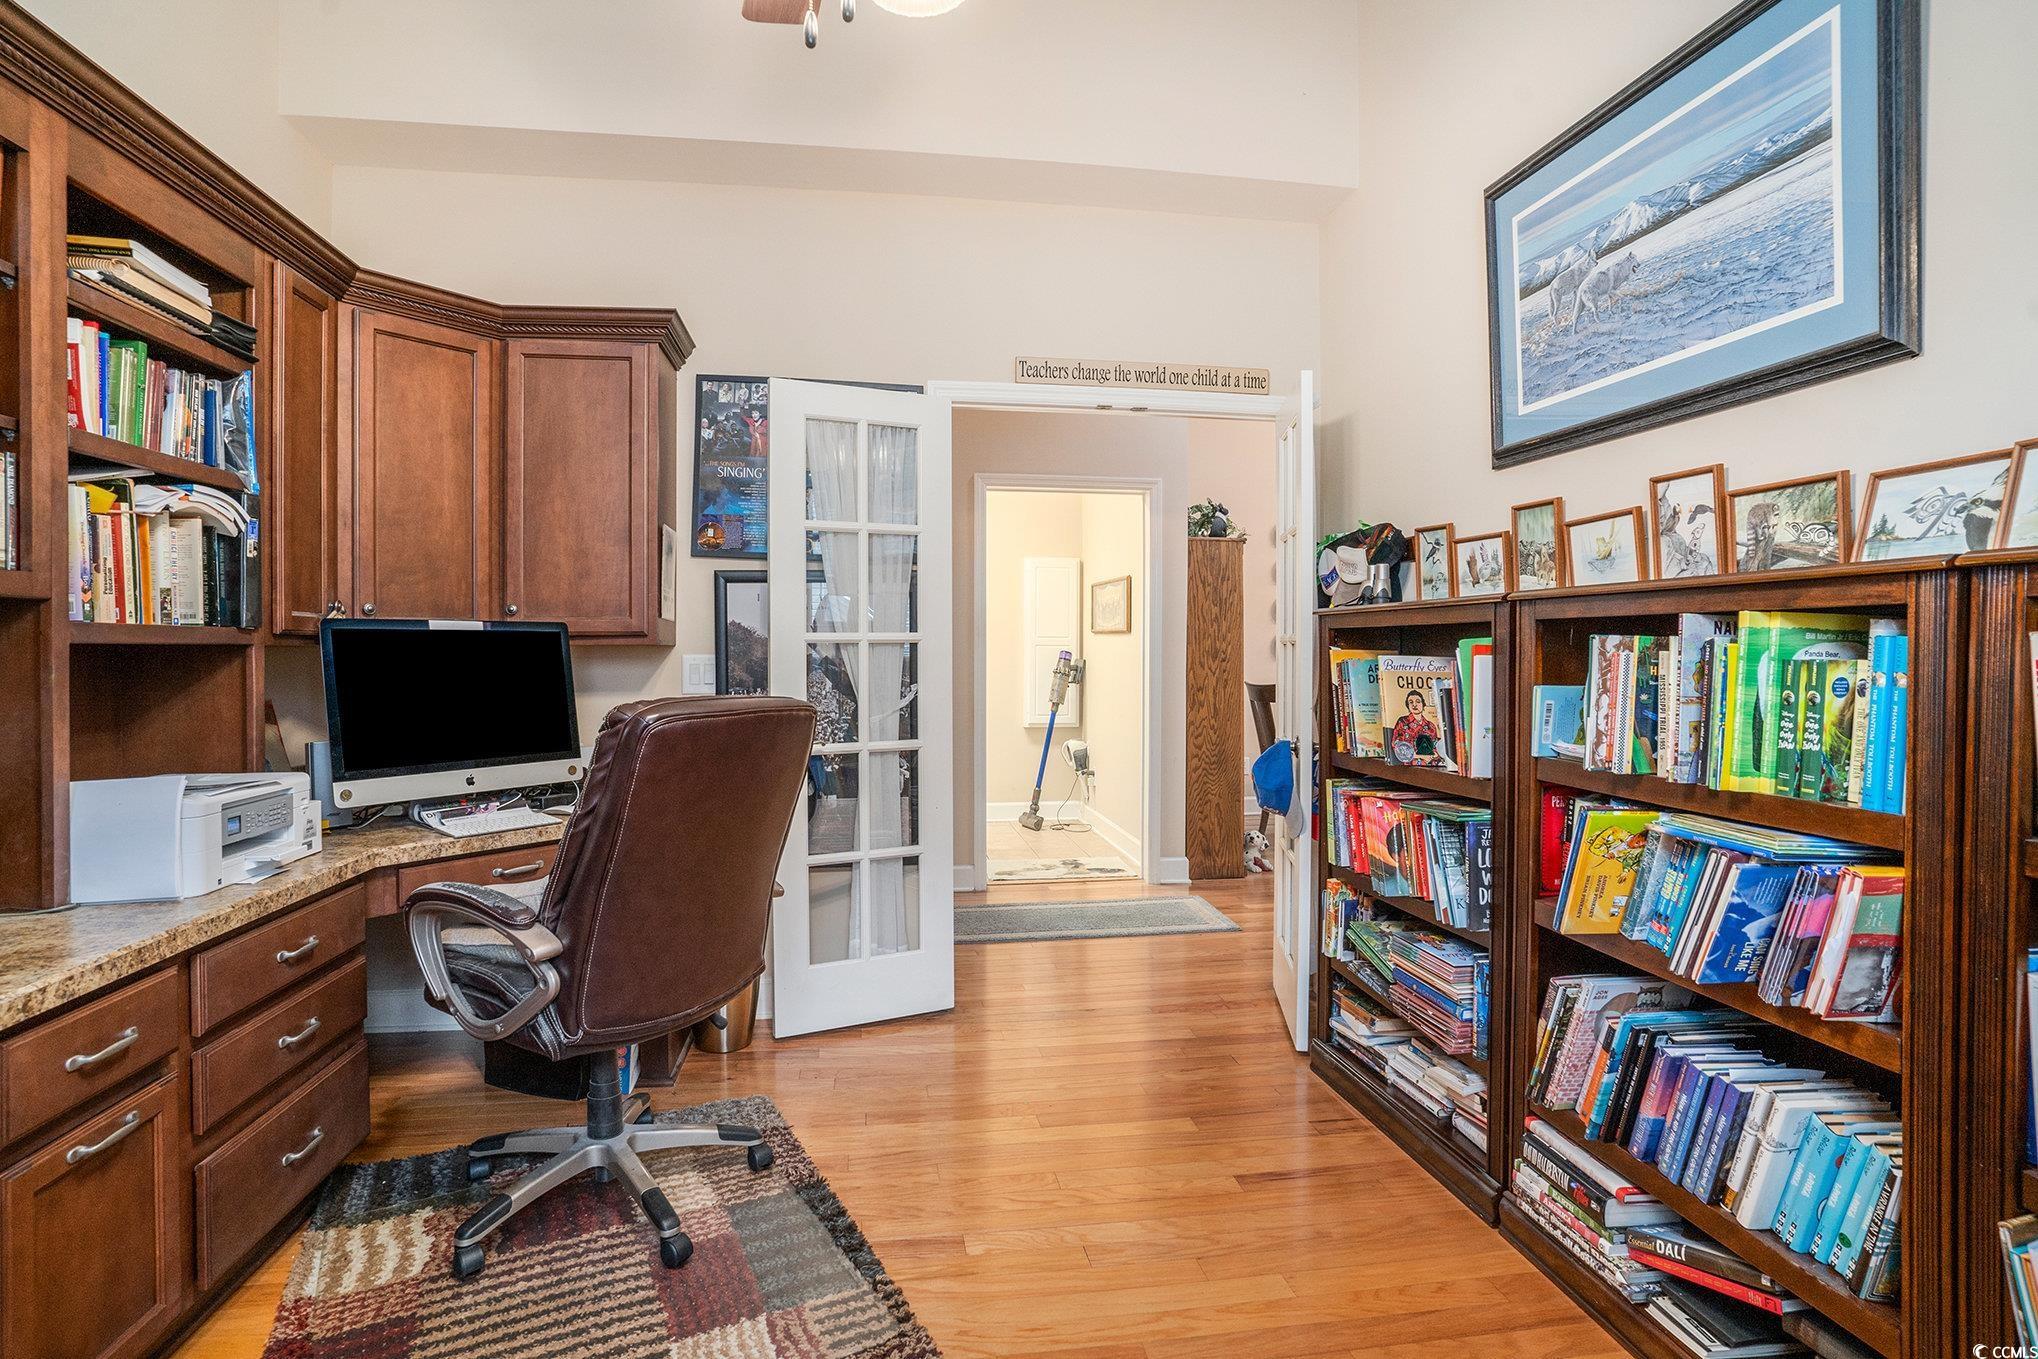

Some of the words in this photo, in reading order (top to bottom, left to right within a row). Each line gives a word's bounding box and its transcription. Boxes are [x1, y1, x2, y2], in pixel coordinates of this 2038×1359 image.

[1018, 360, 1068, 379] Teachers
[1072, 362, 1111, 384] change
[1114, 364, 1131, 382] the
[1134, 366, 1166, 384] world
[1169, 372, 1189, 386] one
[1191, 368, 1218, 387] child
[1221, 373, 1231, 388] at
[1234, 376, 1240, 388] a
[1244, 372, 1266, 390] time
[7, 477, 16, 504] DIAMOND
[1805, 632, 1815, 640] Bill
[1383, 658, 1424, 672] Butterfly
[1427, 659, 1448, 672] Eyes
[1804, 650, 1823, 658] Panda
[1825, 650, 1840, 658] Bear,
[1658, 674, 1667, 714] MISSISSIPPI
[1868, 703, 1877, 739] PHANTOM
[1889, 705, 1898, 742] PHANTOM
[1864, 743, 1875, 787] TOLLBOOTH
[1885, 745, 1896, 790] TOLLBOOTH
[1582, 875, 1590, 893] BRIAN
[1594, 874, 1603, 893] DAVIS
[1598, 874, 1607, 899] ANDREA
[1576, 893, 1585, 918] PINKNEY
[1587, 893, 1597, 918] PINKNEY
[1740, 941, 1750, 958] LIKE
[1734, 956, 1747, 972] ME
[1872, 1190, 1889, 1223] WRINKLE
[1628, 1234, 1655, 1250] Essential
[1656, 1239, 1686, 1261] DALÍ
[1863, 1233, 1876, 1253] TIME
